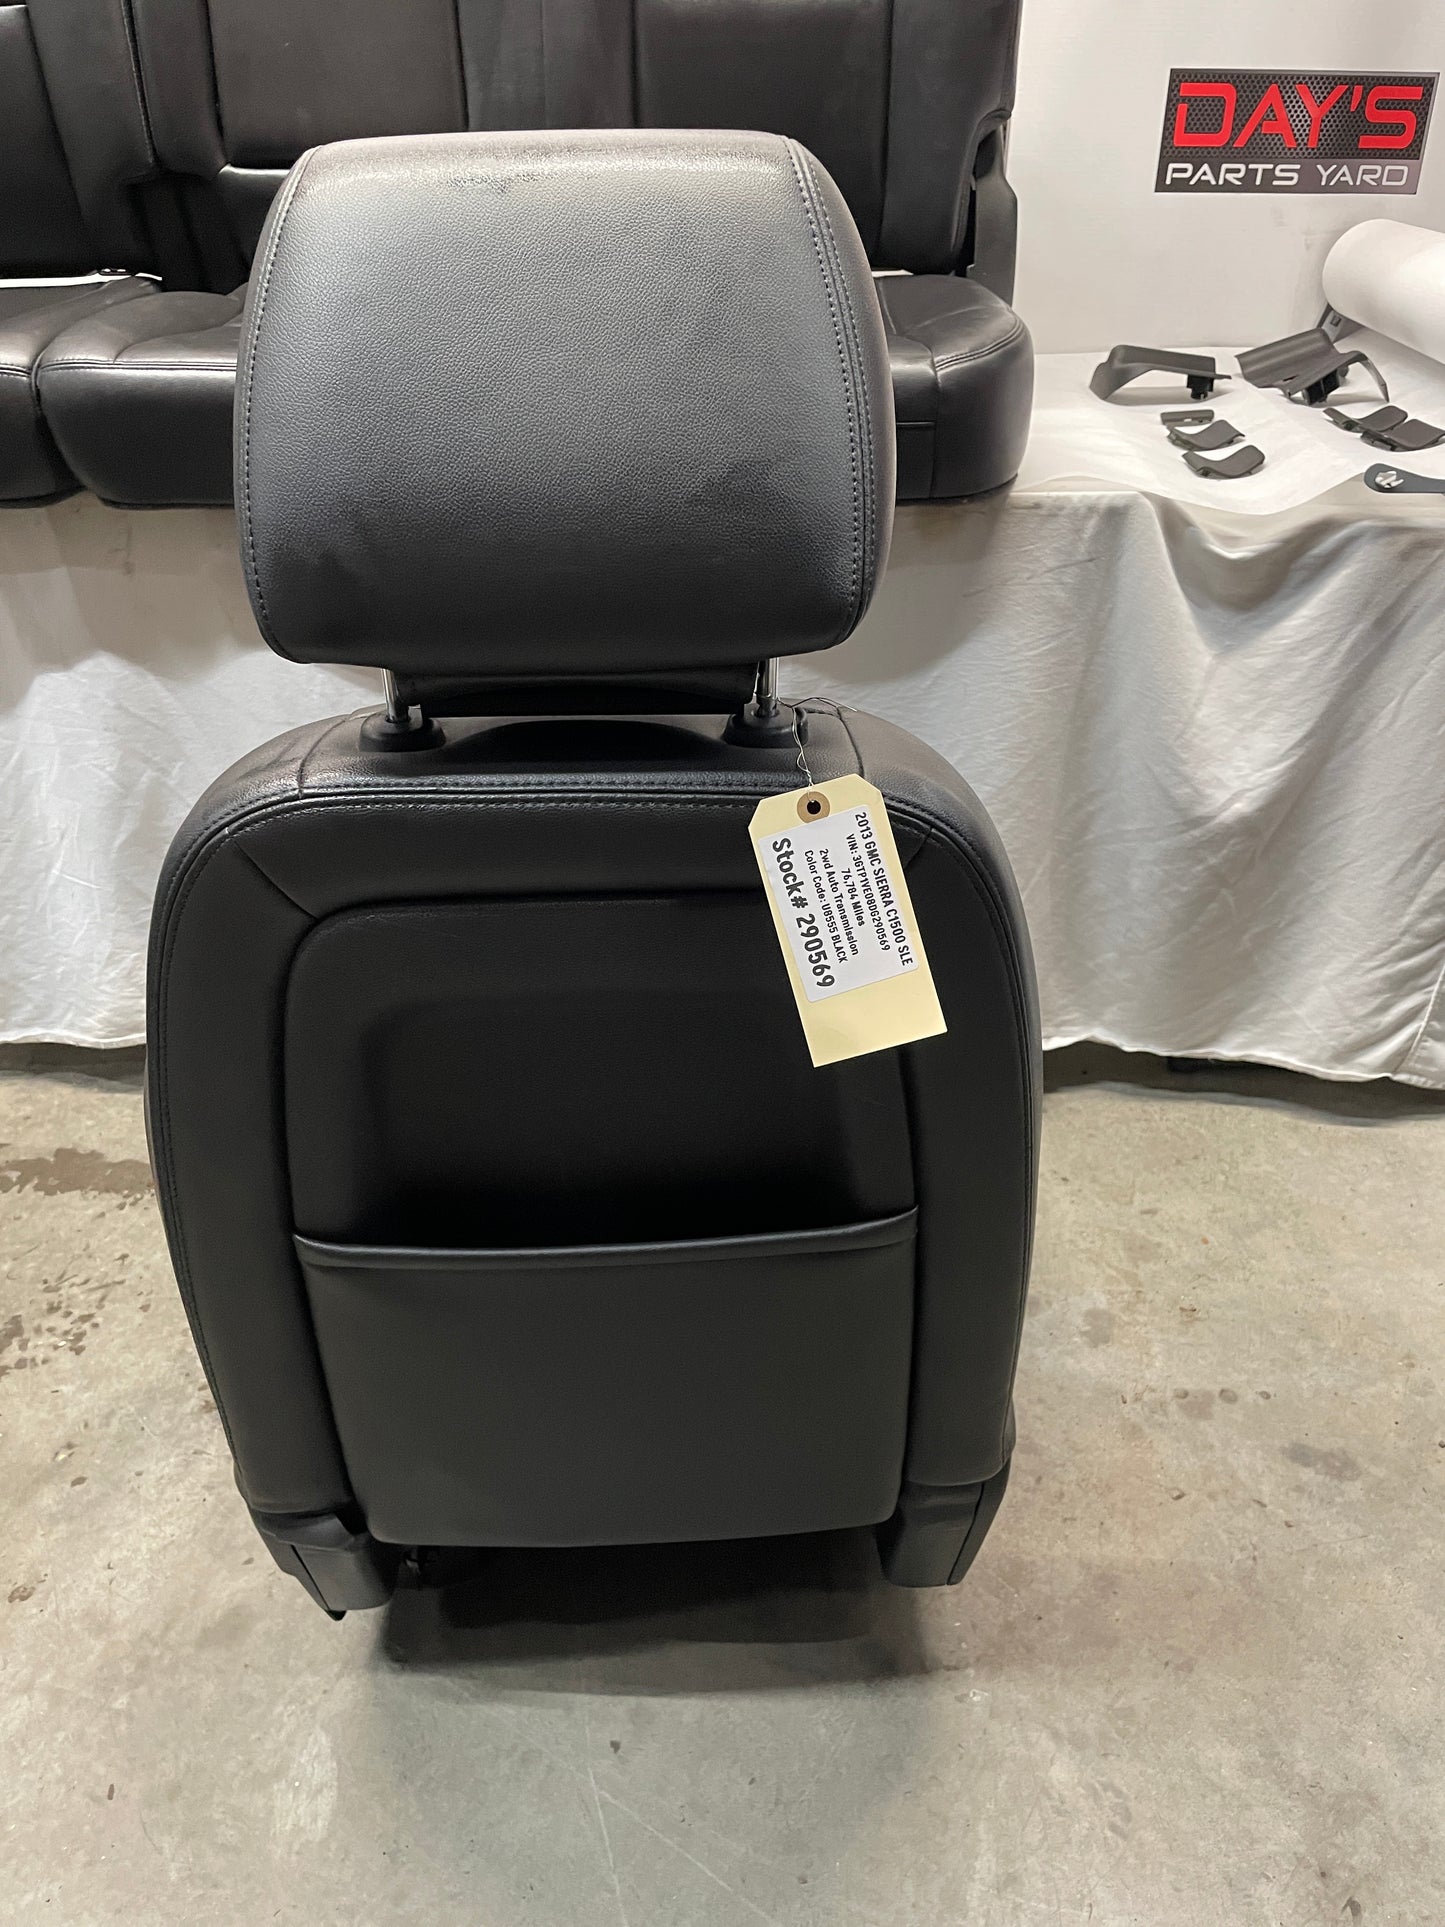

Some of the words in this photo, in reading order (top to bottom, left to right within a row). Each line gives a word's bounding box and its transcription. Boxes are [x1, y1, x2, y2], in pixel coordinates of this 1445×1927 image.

[1173, 82, 1424, 149] DAY'S
[1165, 163, 1301, 185] PARTS
[1316, 164, 1408, 186] YARD
[854, 811, 872, 839] 2013
[819, 848, 833, 869] 2wd
[864, 840, 881, 866] GMC
[825, 871, 838, 892] Auto
[841, 867, 858, 899] 76,784
[851, 900, 864, 926] Miles
[846, 833, 858, 854] VIN:
[852, 854, 890, 950] 3GTP1VE08DG290569
[872, 867, 893, 907] SIERRA
[772, 837, 808, 908] Stock#
[795, 913, 834, 986] 290569
[804, 849, 817, 874] Color
[812, 875, 826, 902] Code:
[821, 902, 838, 933] U8555
[830, 934, 847, 963] BLACK
[833, 892, 858, 955] Transmission
[886, 908, 905, 943] C1500
[897, 944, 913, 965] SLE
